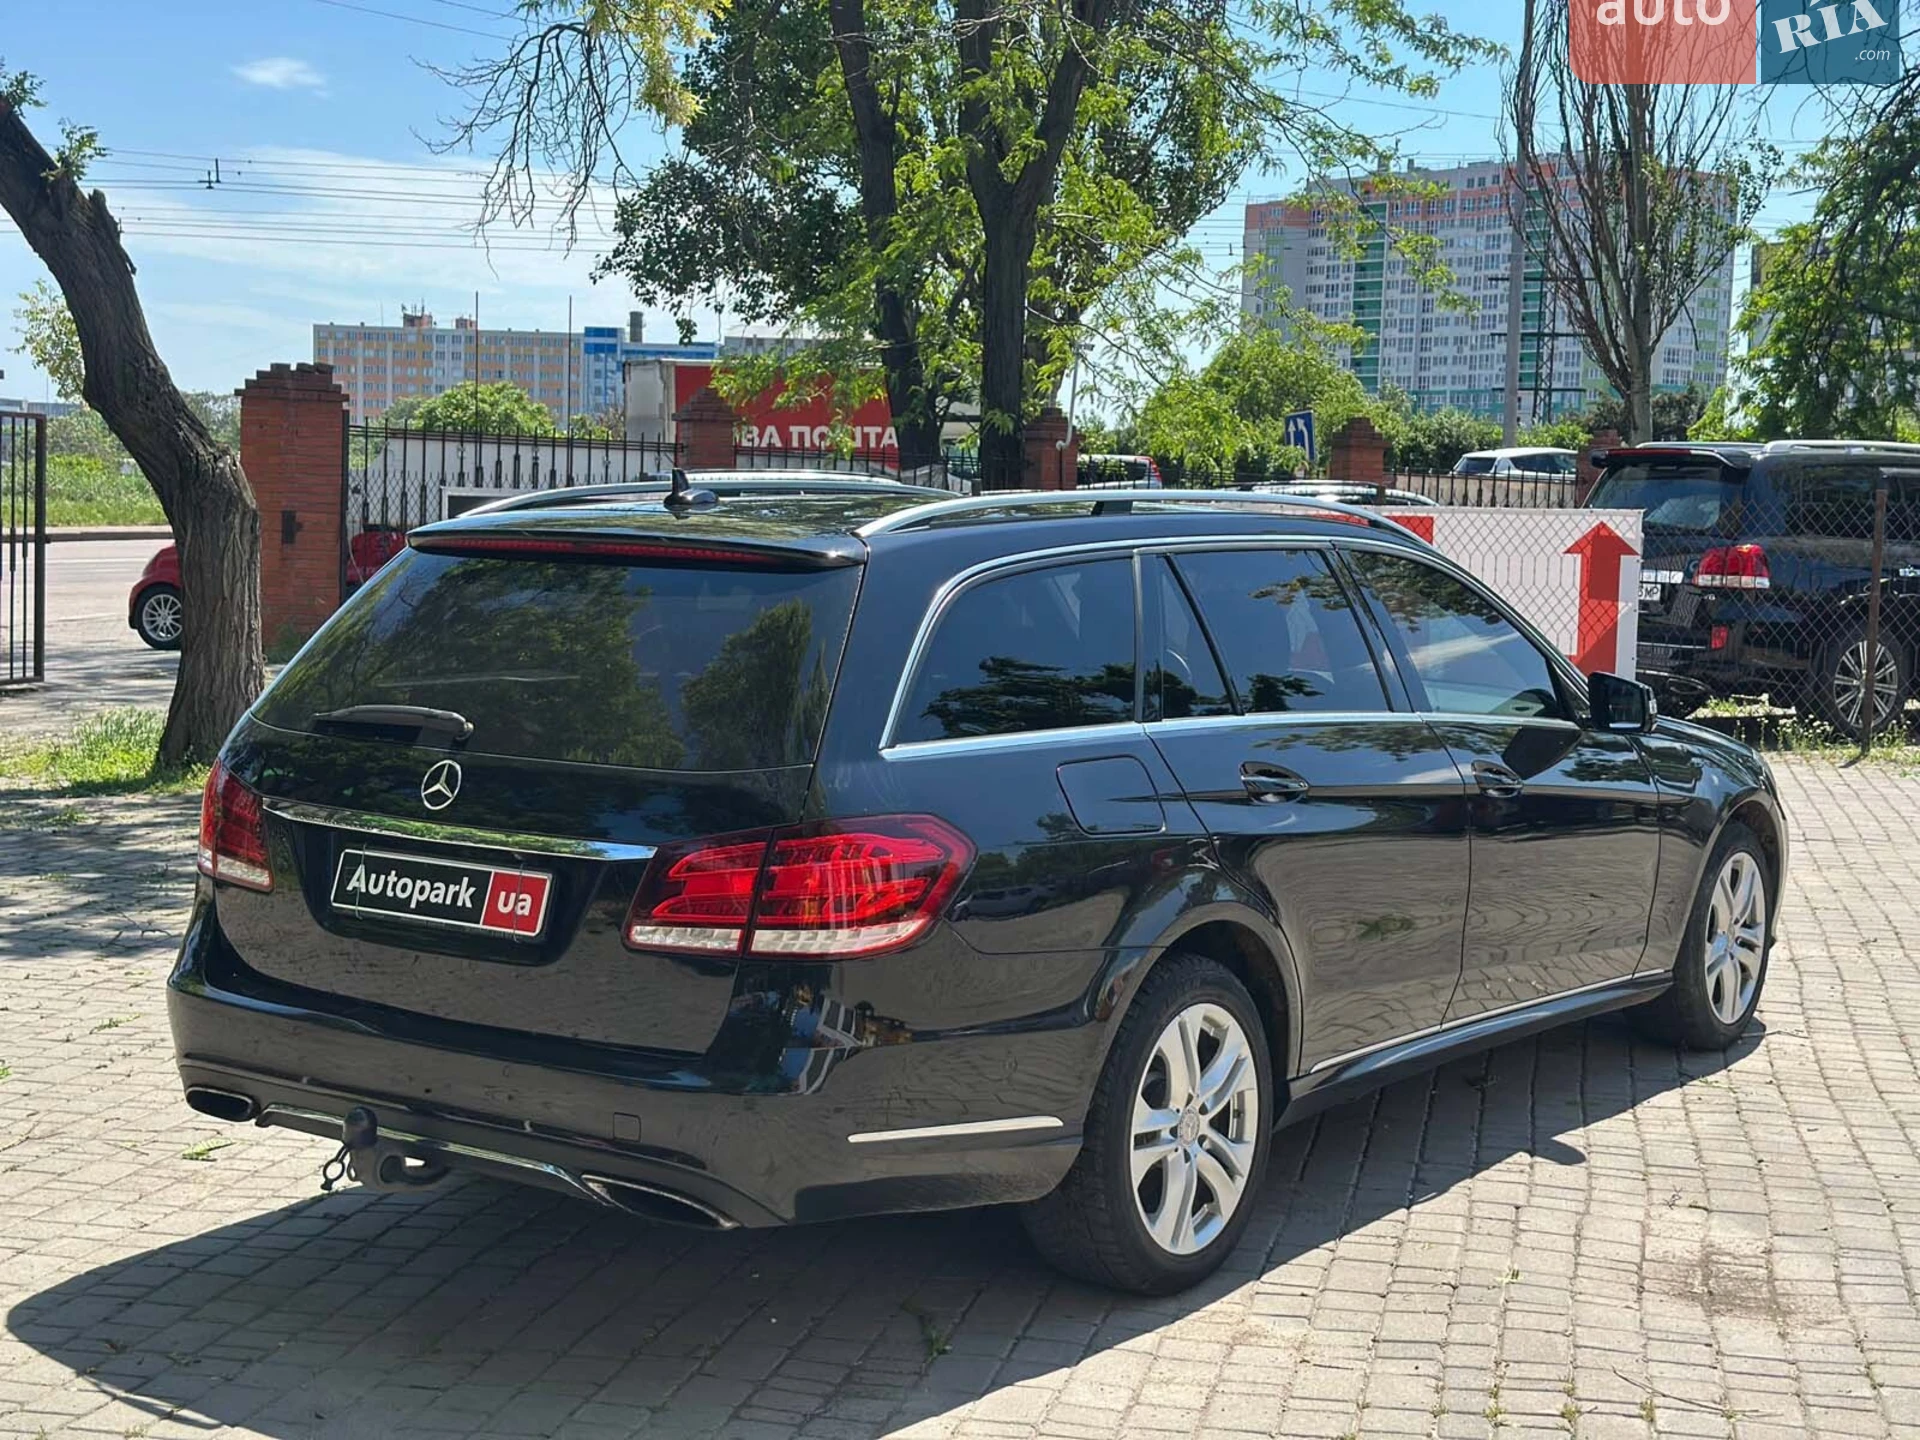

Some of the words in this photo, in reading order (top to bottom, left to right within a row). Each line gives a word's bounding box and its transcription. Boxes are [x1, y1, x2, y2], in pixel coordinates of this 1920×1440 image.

[789, 425, 898, 449] ПОТА
[346, 864, 477, 909] Autopark
[497, 890, 532, 916] ua
